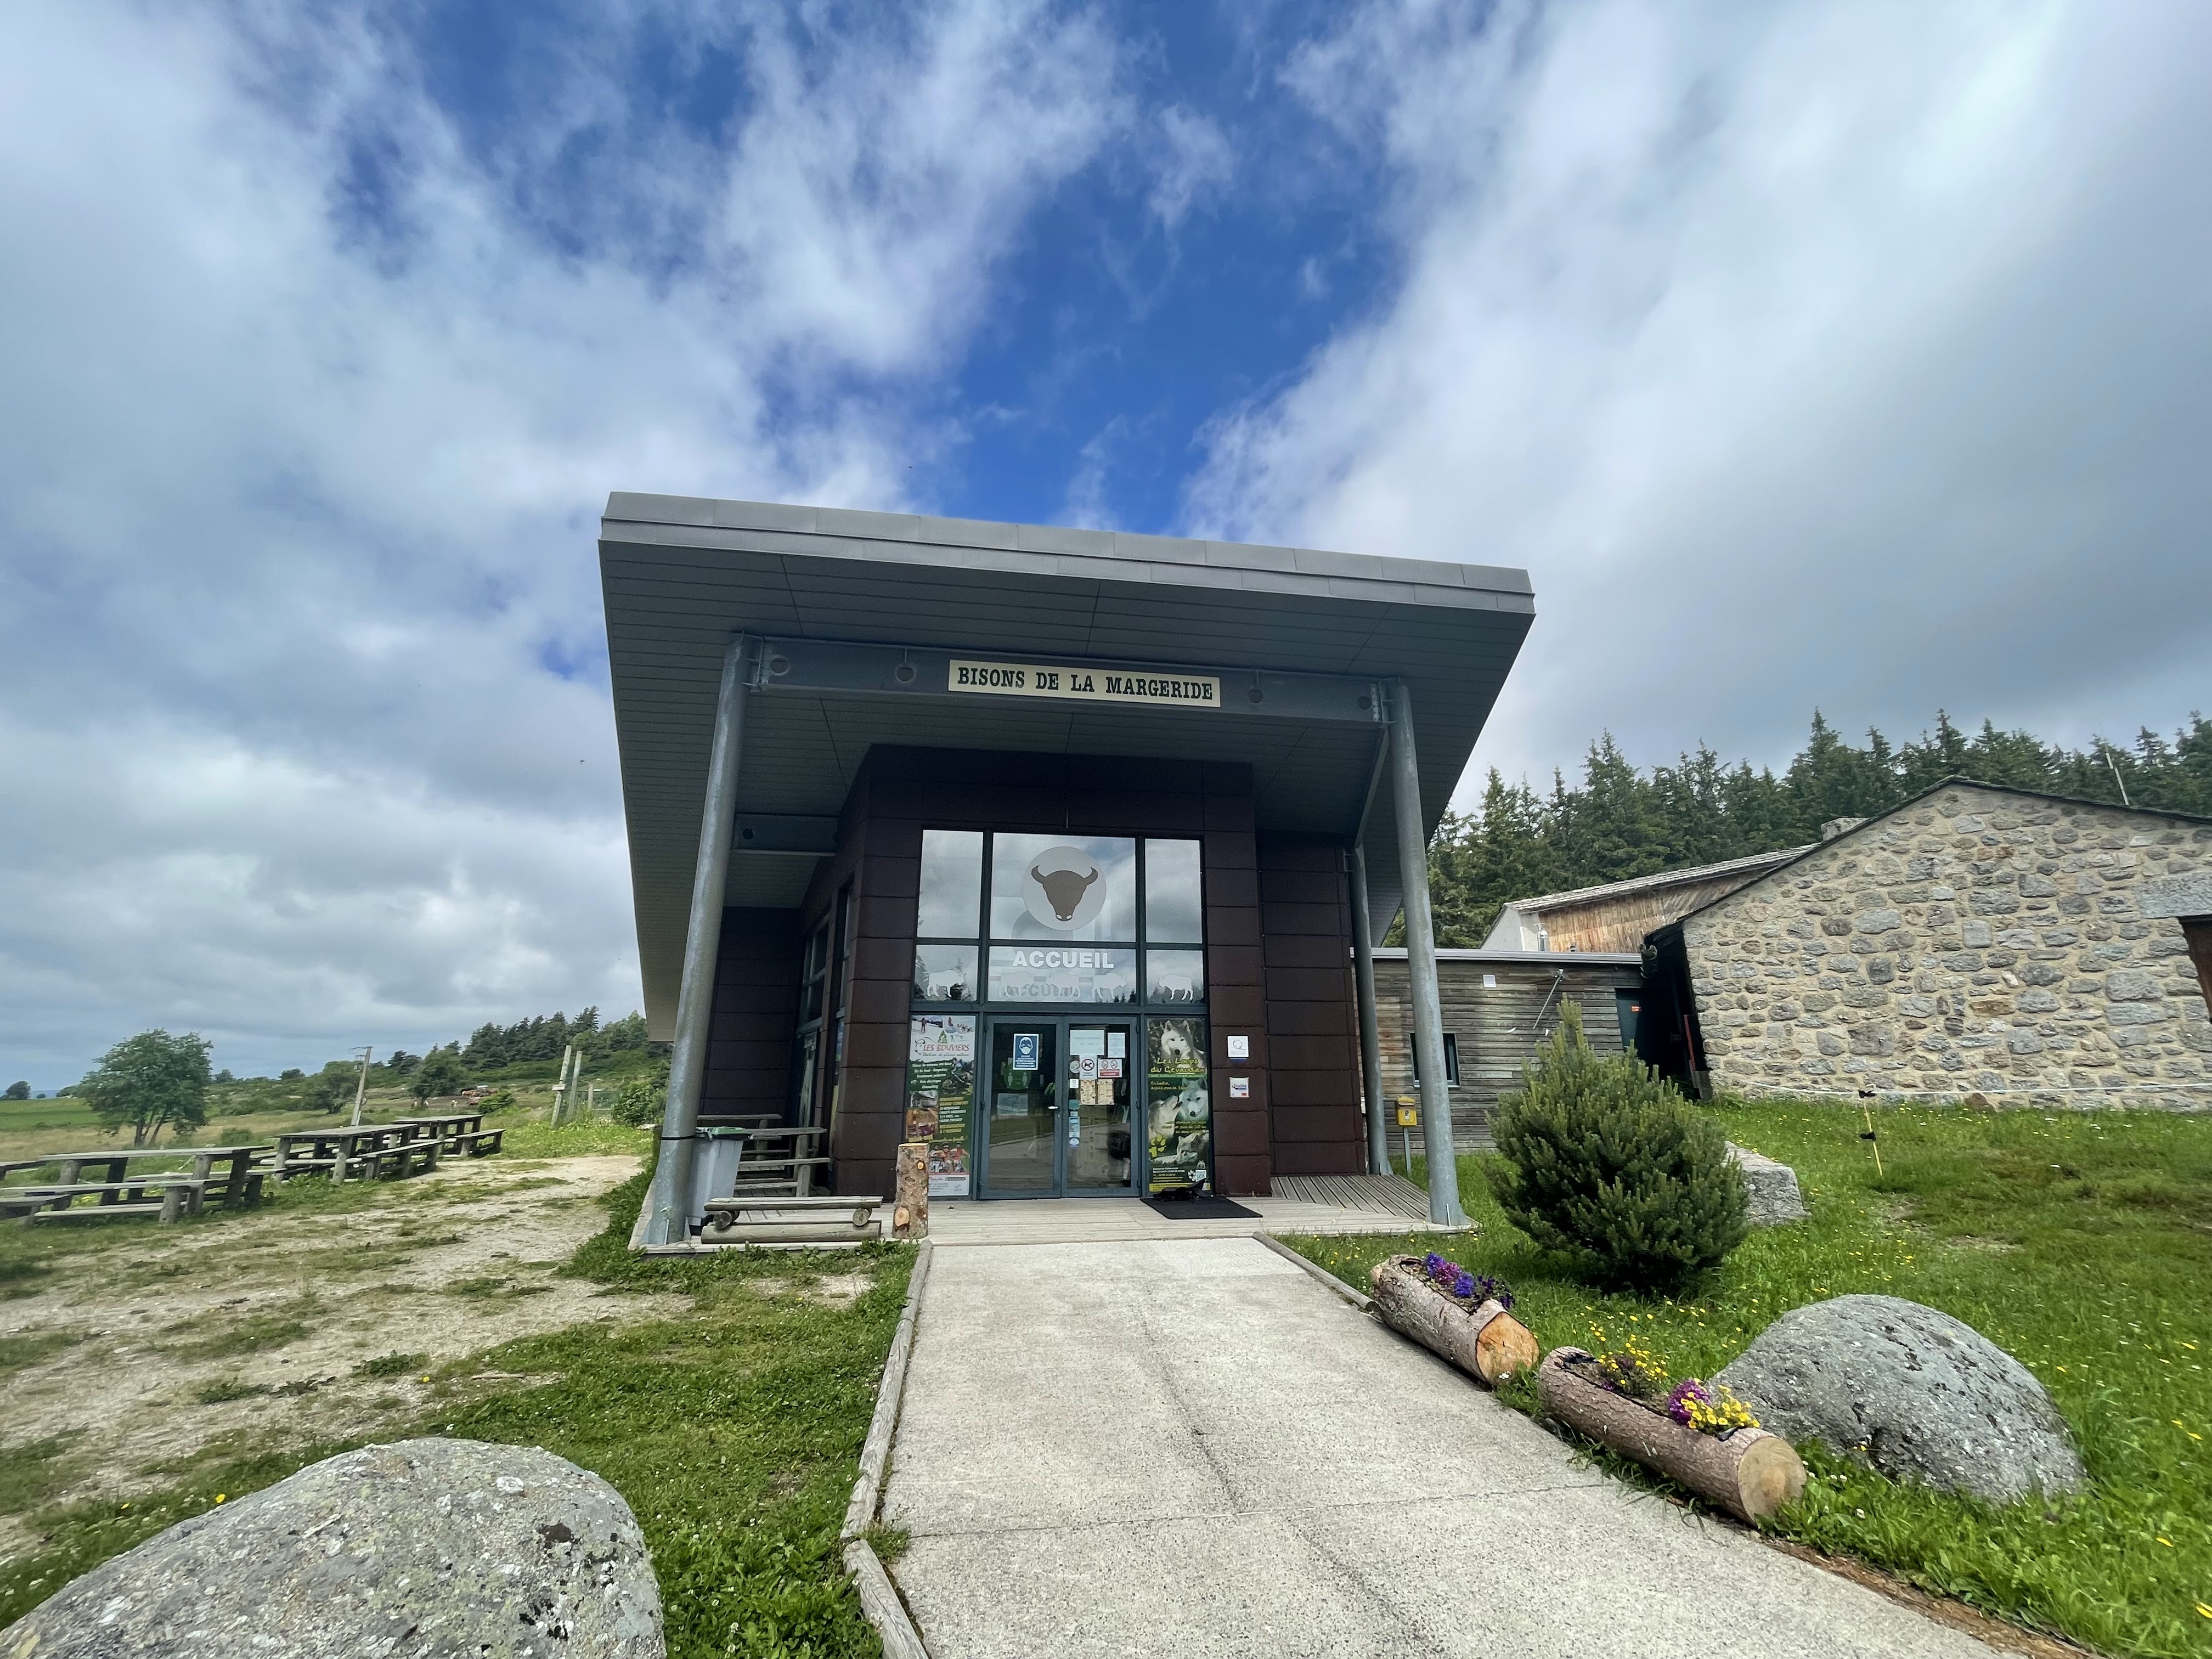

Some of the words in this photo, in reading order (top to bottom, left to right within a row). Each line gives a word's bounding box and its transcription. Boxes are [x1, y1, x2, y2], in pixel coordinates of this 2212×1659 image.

[957, 667, 1025, 688] BISONS
[1036, 672, 1059, 690] DE
[1071, 674, 1095, 692] LA
[1105, 676, 1213, 700] MARGERIDE
[1012, 951, 1114, 968] ACCUEIL
[1175, 1057, 1199, 1065] Loups
